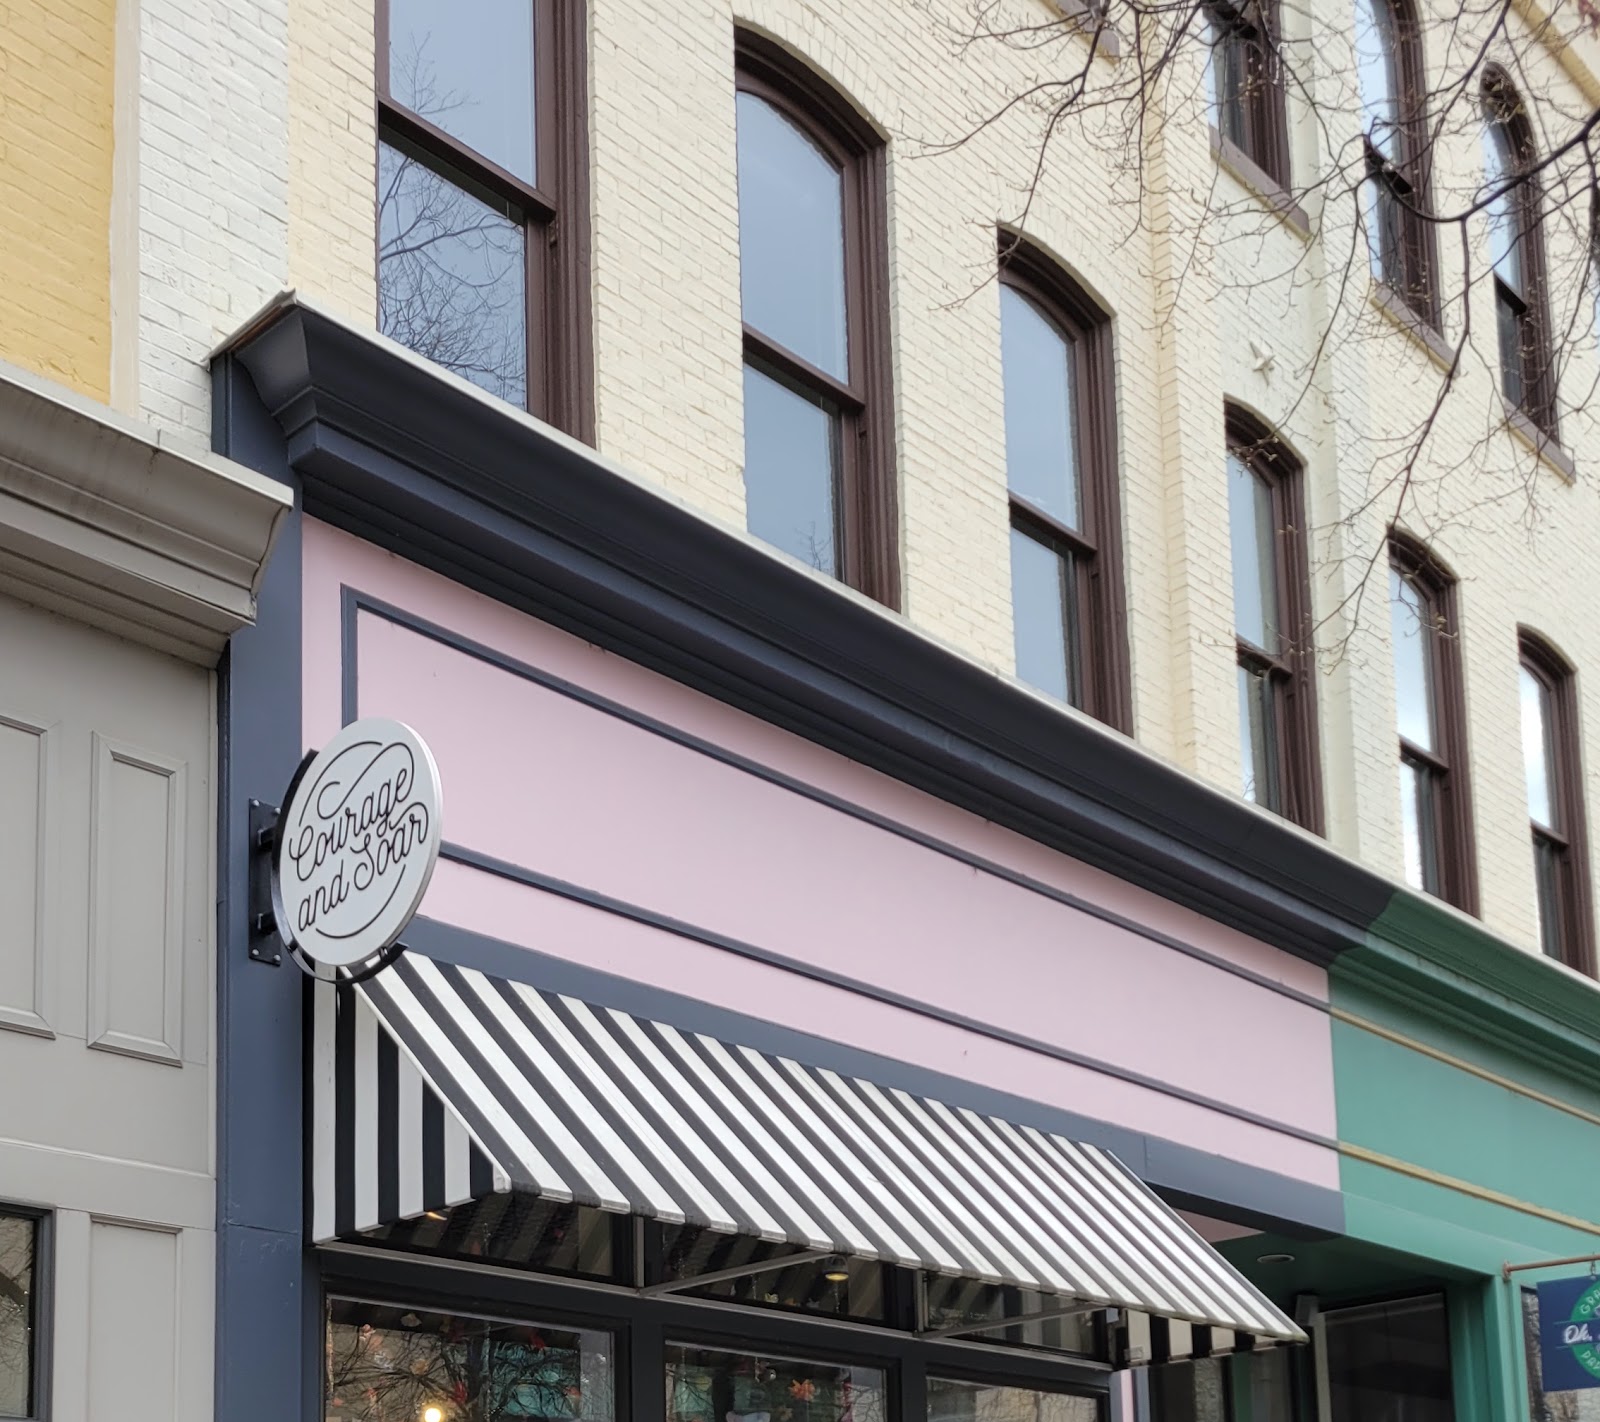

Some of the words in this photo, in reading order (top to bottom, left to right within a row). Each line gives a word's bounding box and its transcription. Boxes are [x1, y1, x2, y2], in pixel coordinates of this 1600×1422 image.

[289, 765, 414, 882] Courage
[298, 859, 350, 931] and
[350, 802, 428, 890] Soar
